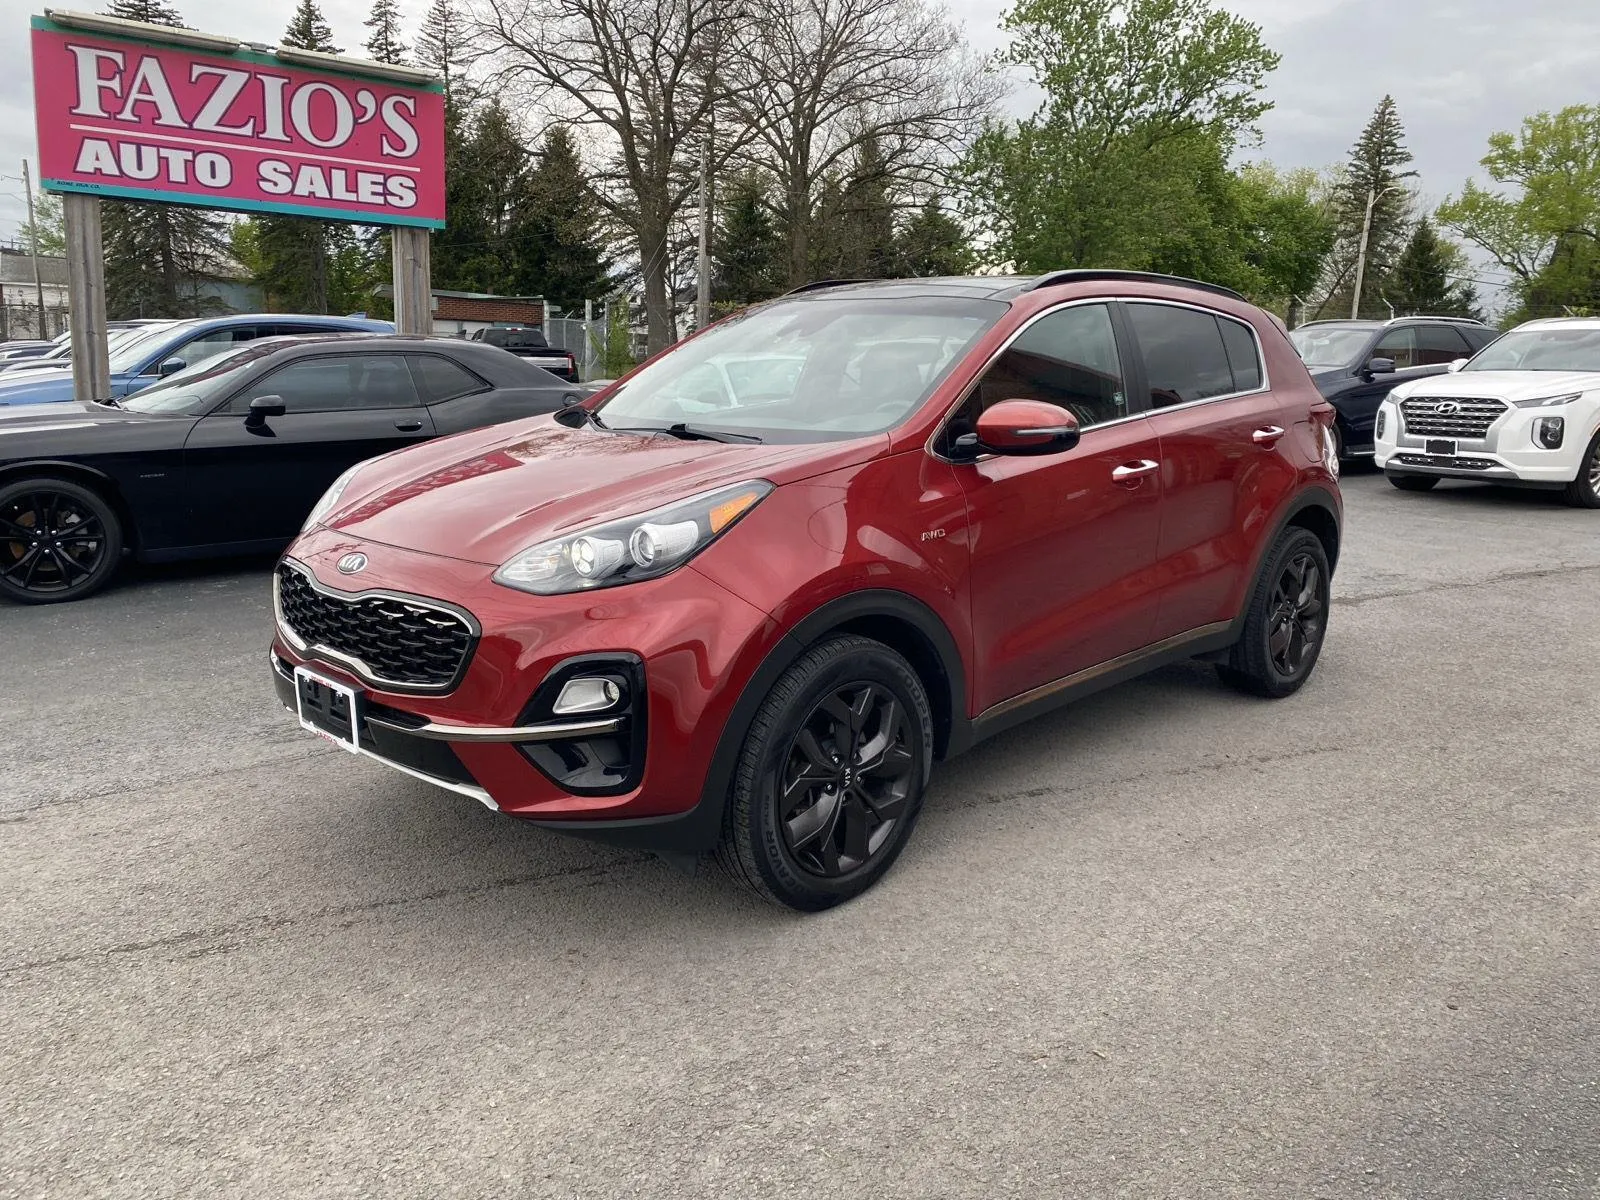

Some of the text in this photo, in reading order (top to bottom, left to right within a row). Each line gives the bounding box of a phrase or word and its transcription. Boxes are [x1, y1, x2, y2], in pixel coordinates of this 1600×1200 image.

[66, 43, 419, 158] FAZIO'S
[73, 137, 417, 208] AUTO SALES
[921, 529, 946, 541] AWD
[338, 554, 364, 571] KIA
